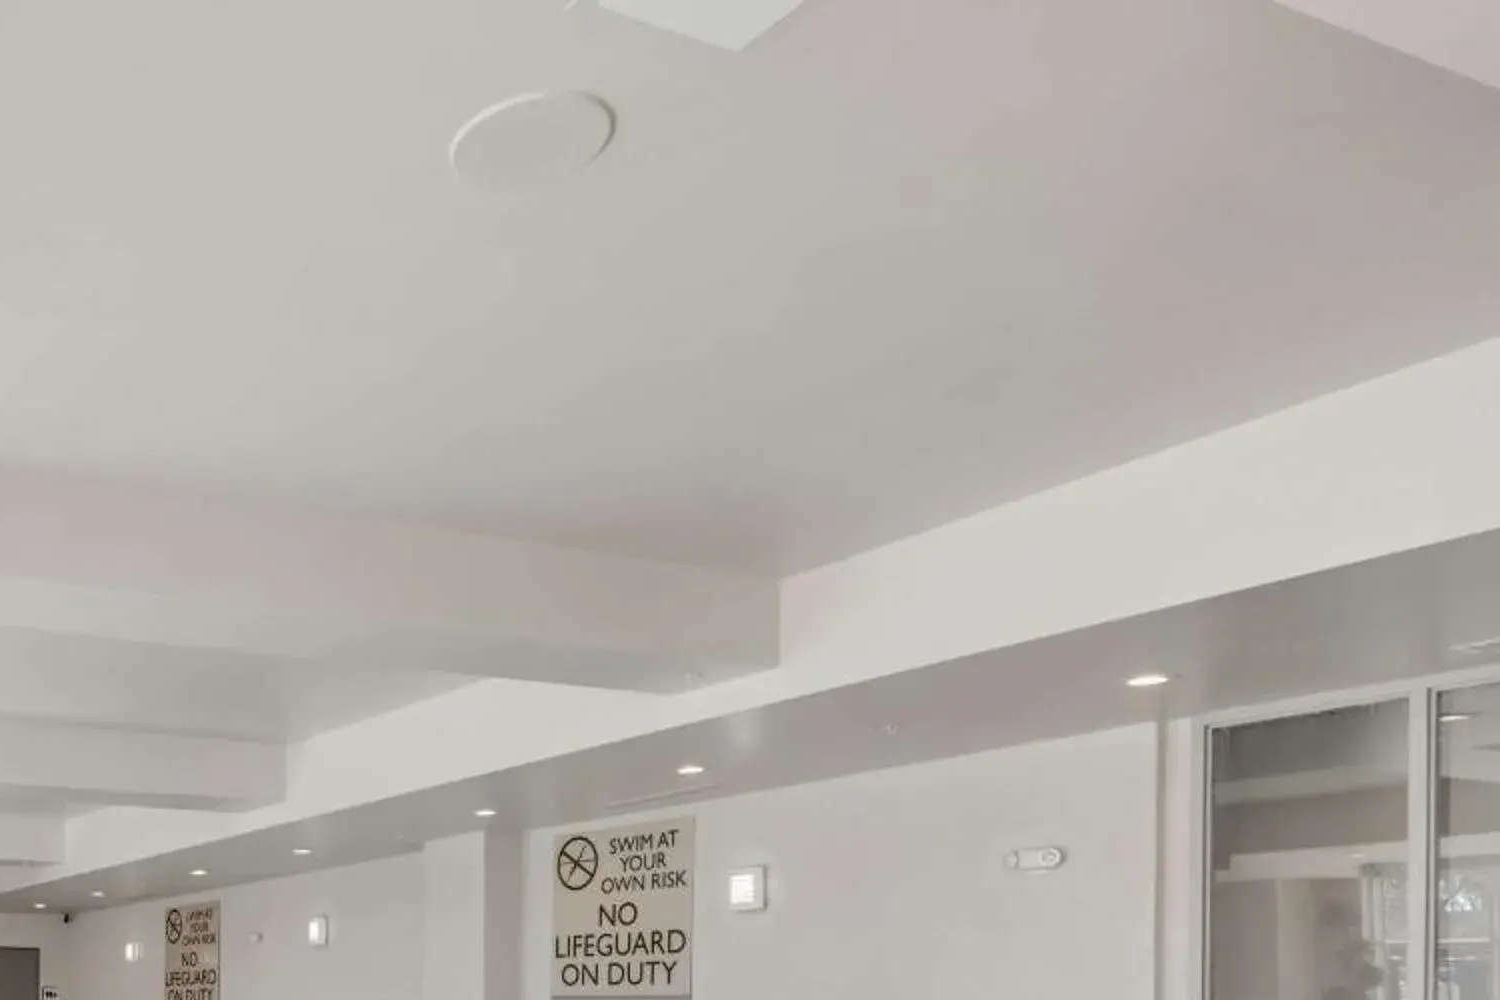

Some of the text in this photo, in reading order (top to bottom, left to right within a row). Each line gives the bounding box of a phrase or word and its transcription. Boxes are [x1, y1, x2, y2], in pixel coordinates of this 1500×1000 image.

[608, 829, 680, 855] SWIM AT
[619, 851, 667, 873] YOUR
[601, 870, 688, 894] OWN RISK
[598, 901, 638, 927] NO
[554, 929, 687, 959] LIFEGUARD
[181, 951, 198, 968] NO
[561, 961, 678, 986] ON DUTY
